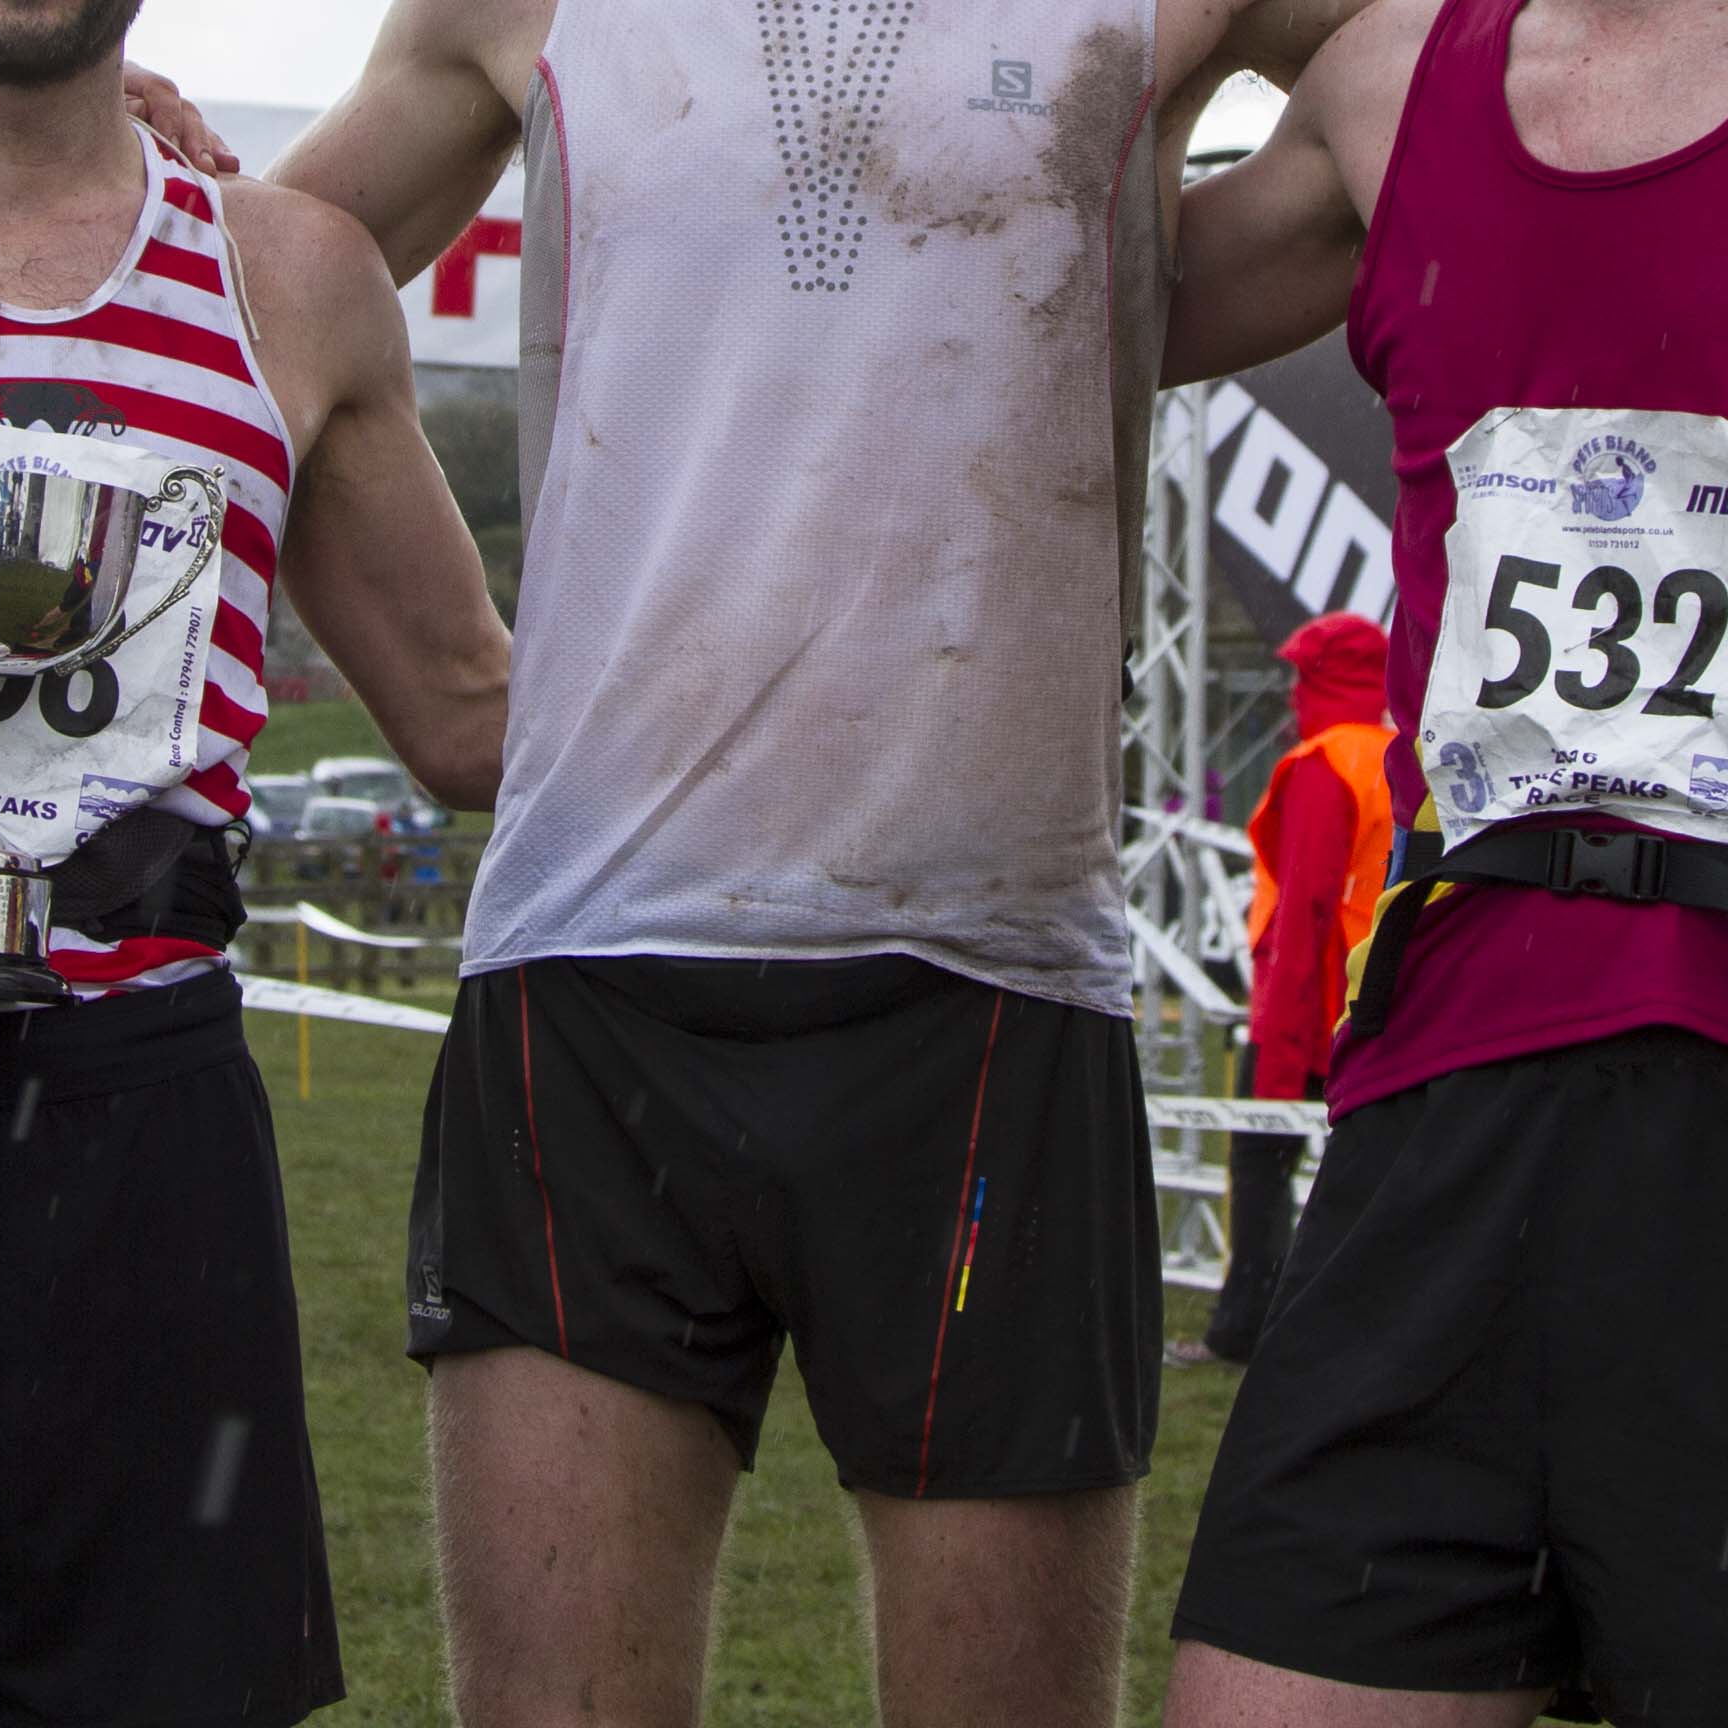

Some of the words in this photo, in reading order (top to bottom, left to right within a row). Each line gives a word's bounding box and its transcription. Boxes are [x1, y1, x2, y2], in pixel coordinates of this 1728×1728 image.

[967, 98, 1056, 116] salomon
[1573, 437, 1601, 474] PETE
[1605, 435, 1657, 474] BLAND
[1476, 472, 1557, 495] anson
[185, 606, 201, 648] 729071
[179, 652, 195, 688] 07944
[169, 698, 187, 740] Control
[168, 743, 182, 767] Race
[1440, 742, 1487, 813] 3
[1572, 771, 1669, 800] PEAKS
